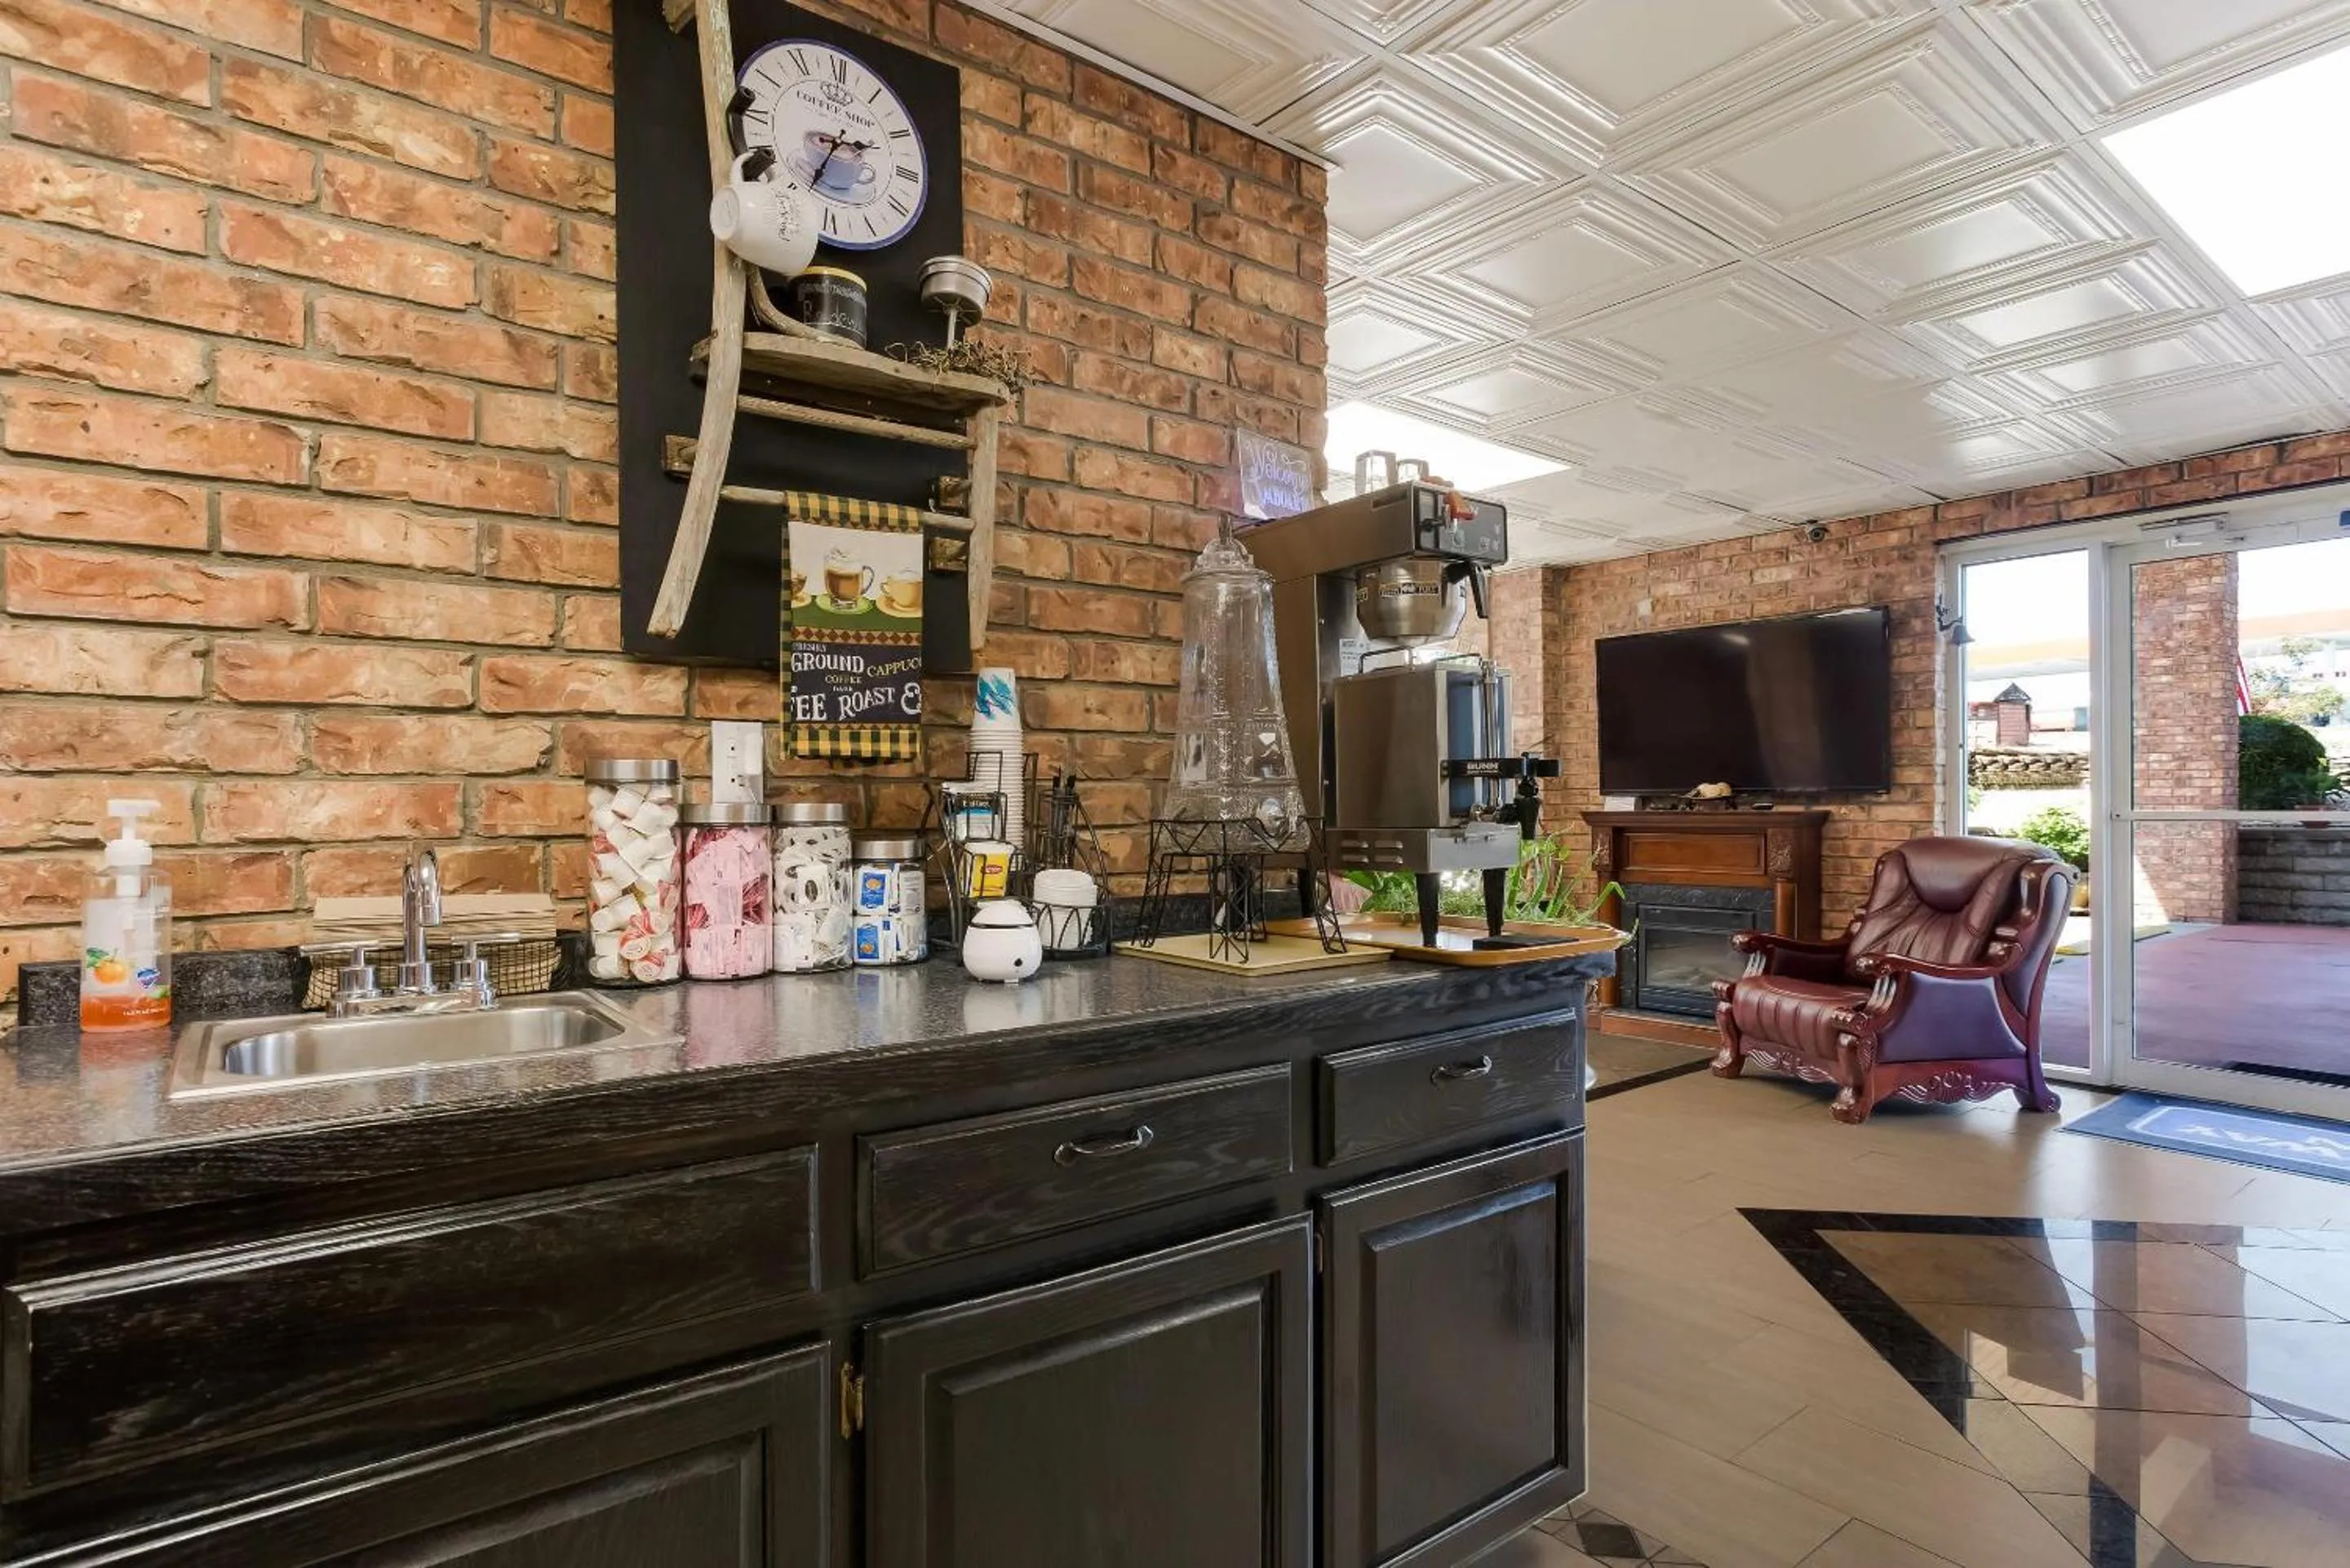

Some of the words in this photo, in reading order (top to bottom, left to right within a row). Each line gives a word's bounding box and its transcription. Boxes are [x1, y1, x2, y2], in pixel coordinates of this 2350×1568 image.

[845, 110, 876, 128] SHOP
[791, 652, 865, 674] GROUND
[824, 675, 862, 684] COFFEE
[791, 692, 828, 722] EE
[837, 686, 896, 721] ROAST
[1467, 761, 1499, 770] BUNN
